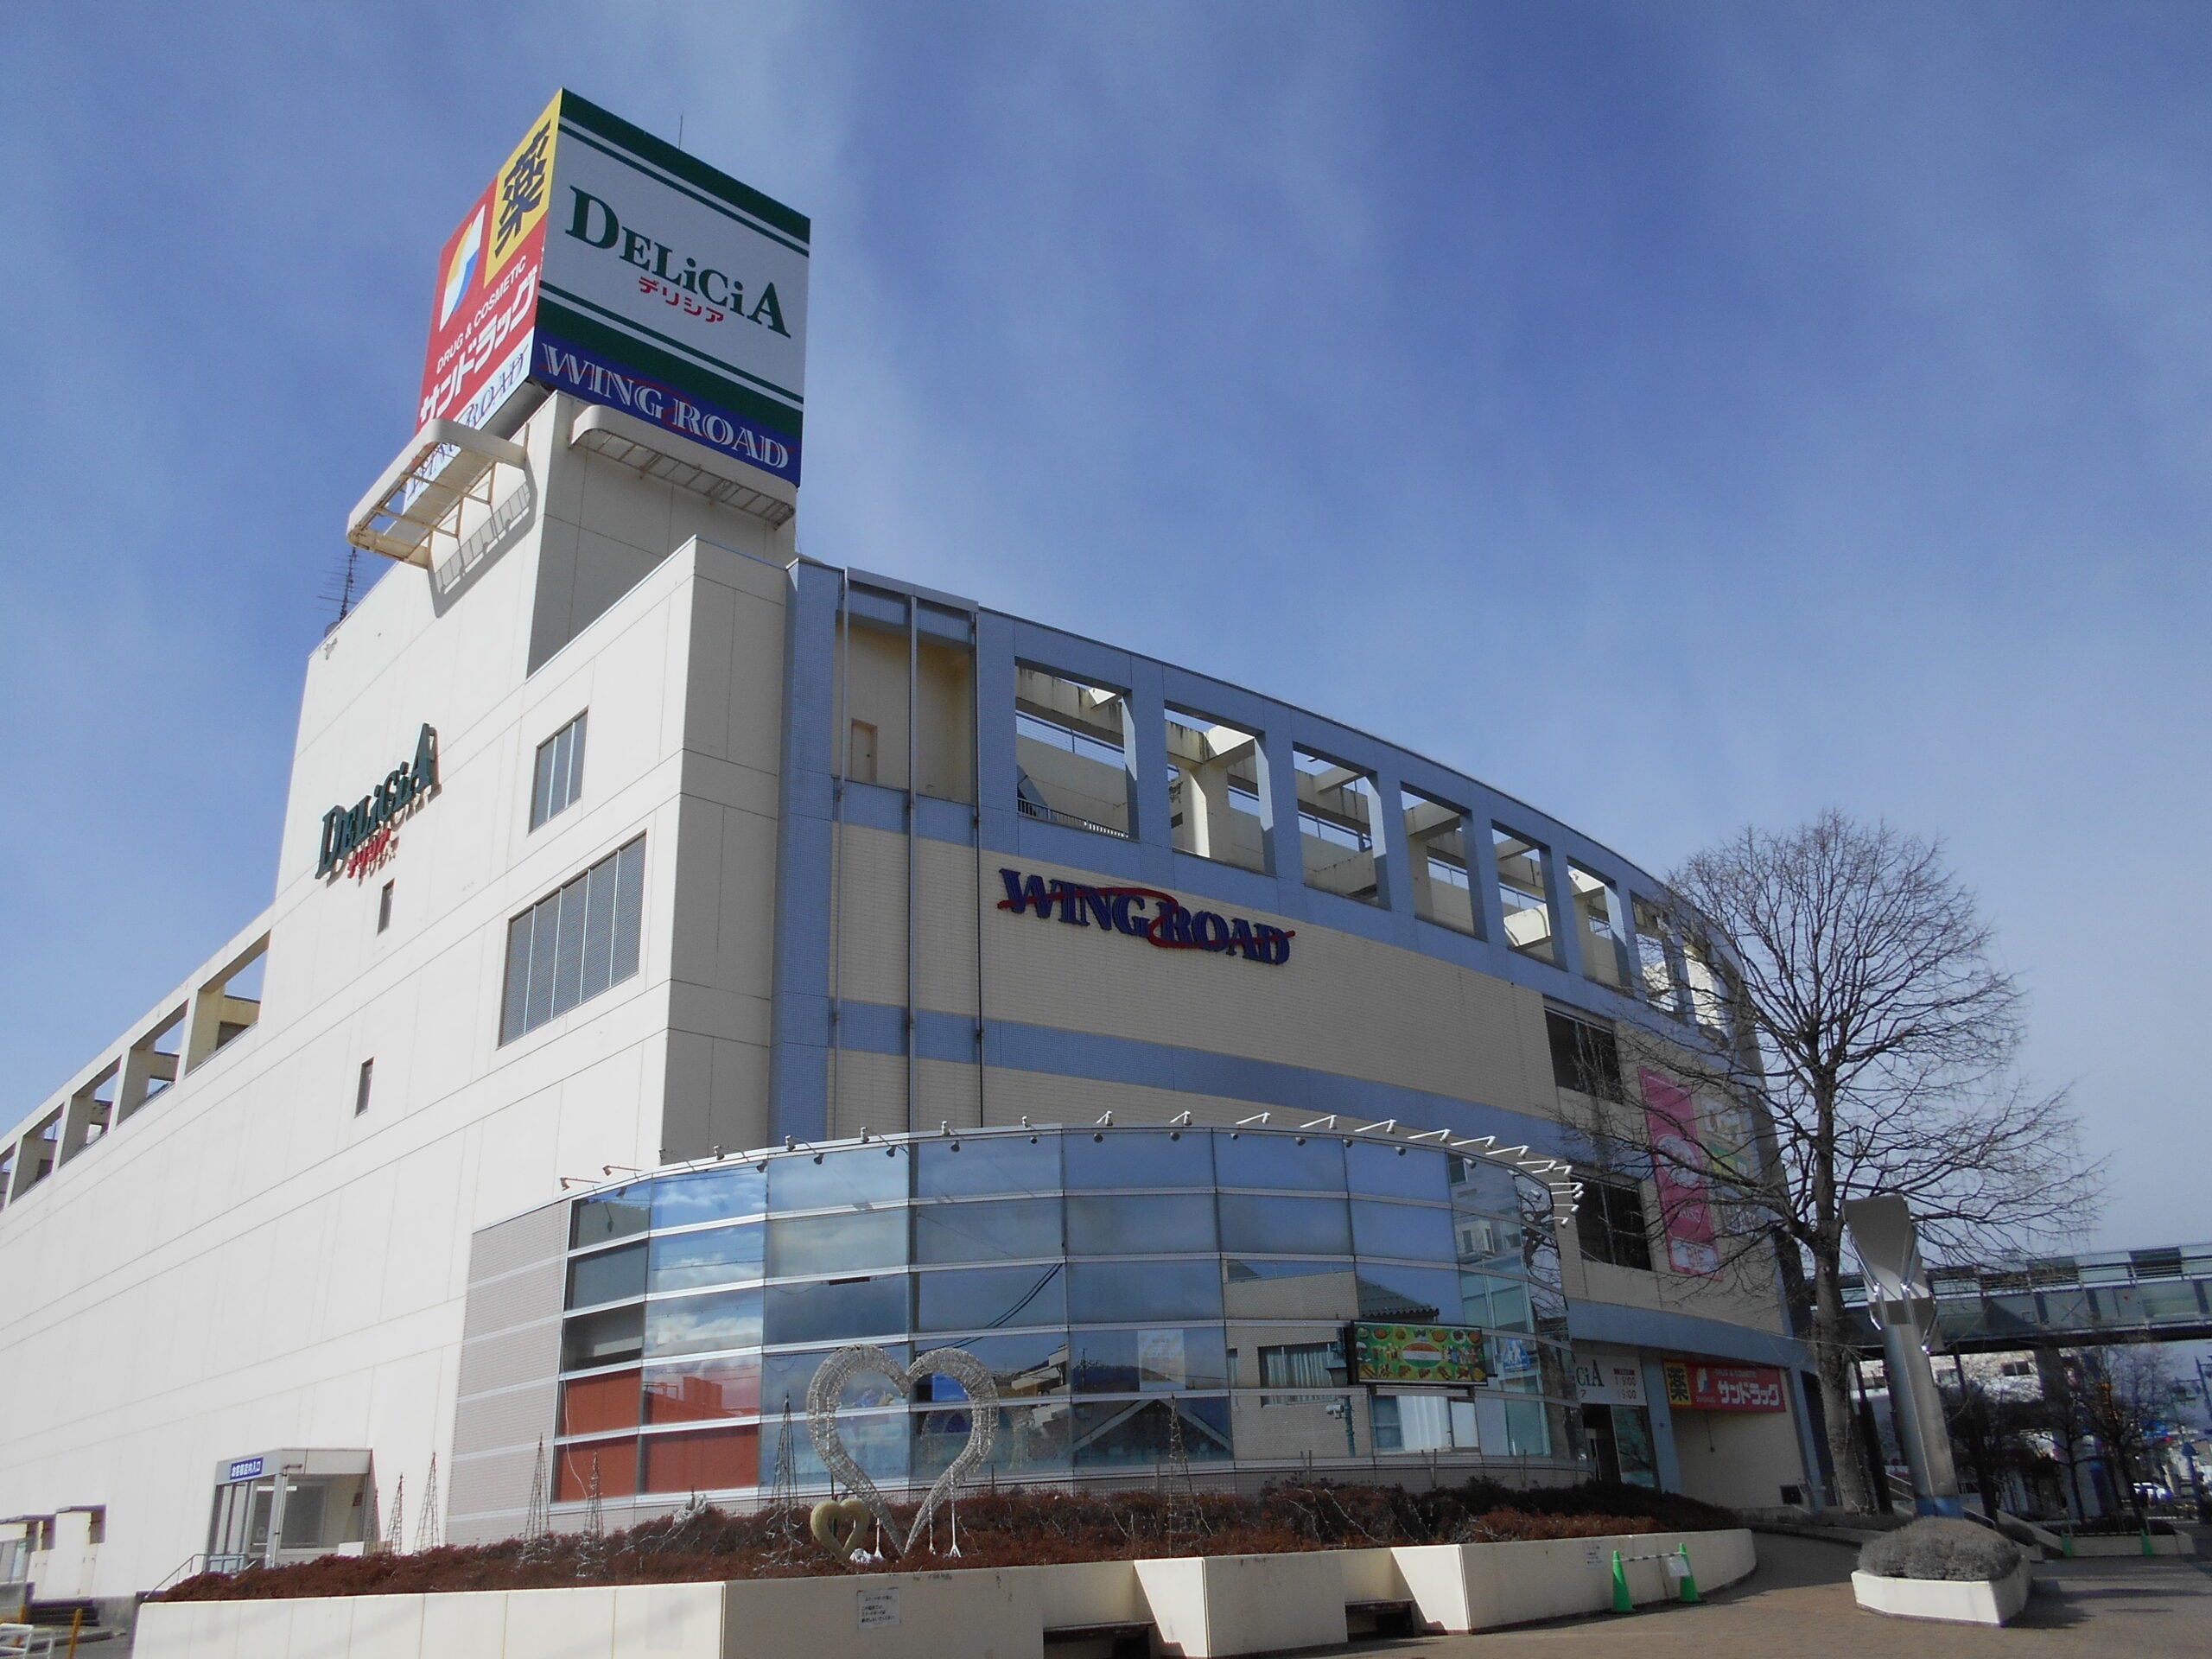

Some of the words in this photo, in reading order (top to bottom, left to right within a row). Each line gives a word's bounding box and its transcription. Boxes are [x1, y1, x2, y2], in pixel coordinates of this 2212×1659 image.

[494, 119, 551, 259] 薬
[436, 333, 464, 374] DRUG
[464, 322, 473, 340] &
[474, 255, 527, 328] COSMETIC
[639, 276, 725, 324] デリシア
[542, 343, 664, 419] WING
[673, 397, 789, 469] ROAD
[998, 868, 1150, 938] WING
[1156, 900, 1291, 965] ROAD
[1575, 1359, 1605, 1388] CiA
